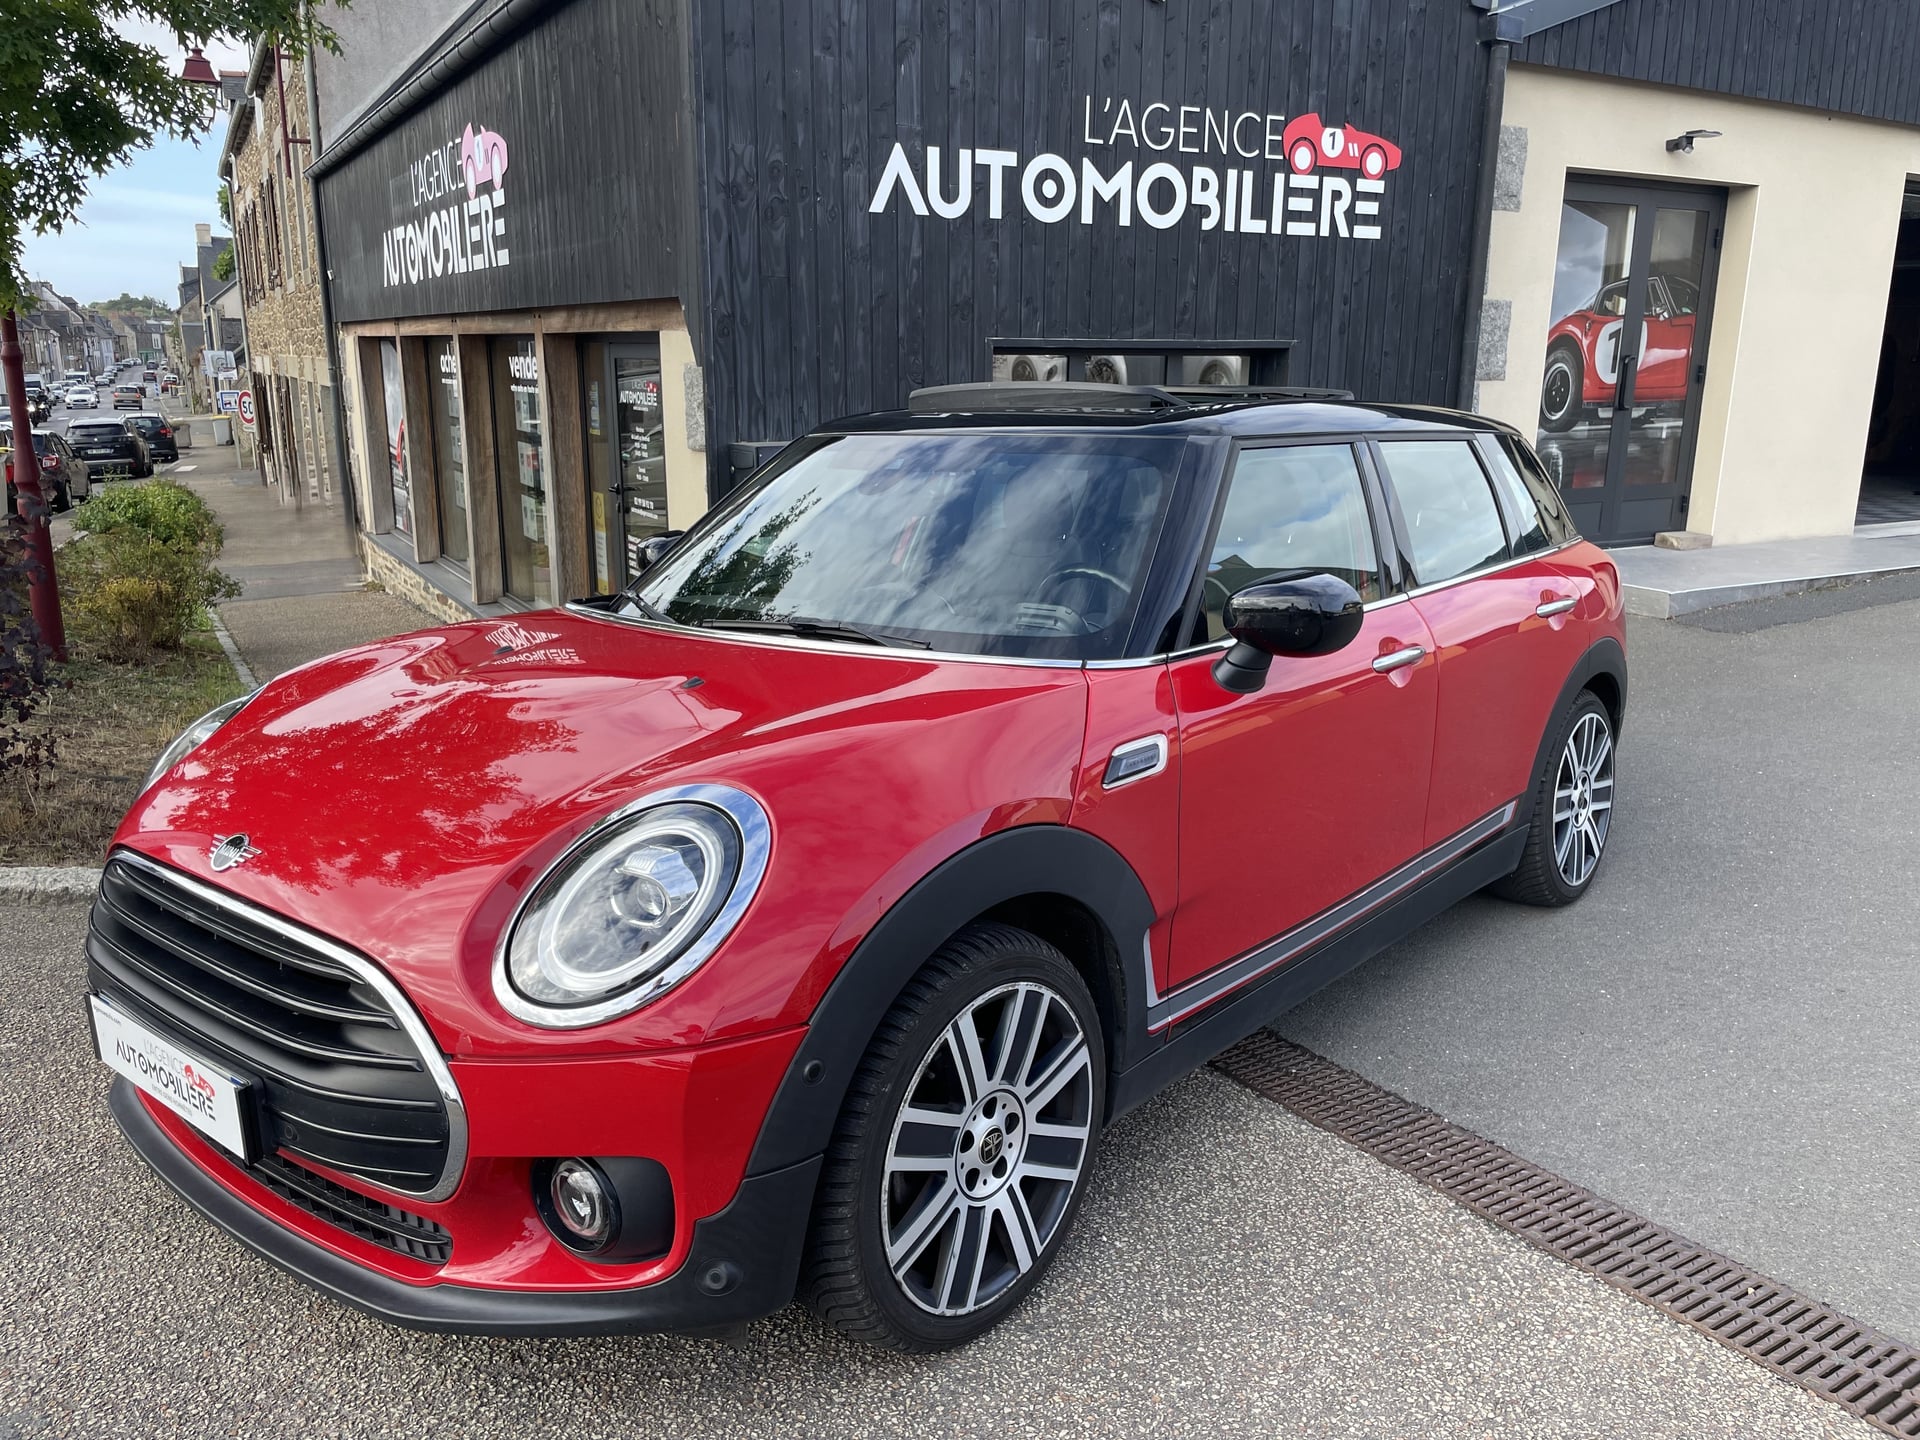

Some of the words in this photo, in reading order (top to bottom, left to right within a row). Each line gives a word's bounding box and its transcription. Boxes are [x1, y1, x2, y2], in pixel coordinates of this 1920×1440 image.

[1083, 95, 1286, 160] L'AGENCE
[1326, 130, 1339, 152] 1
[410, 138, 465, 208] L'AGENCE
